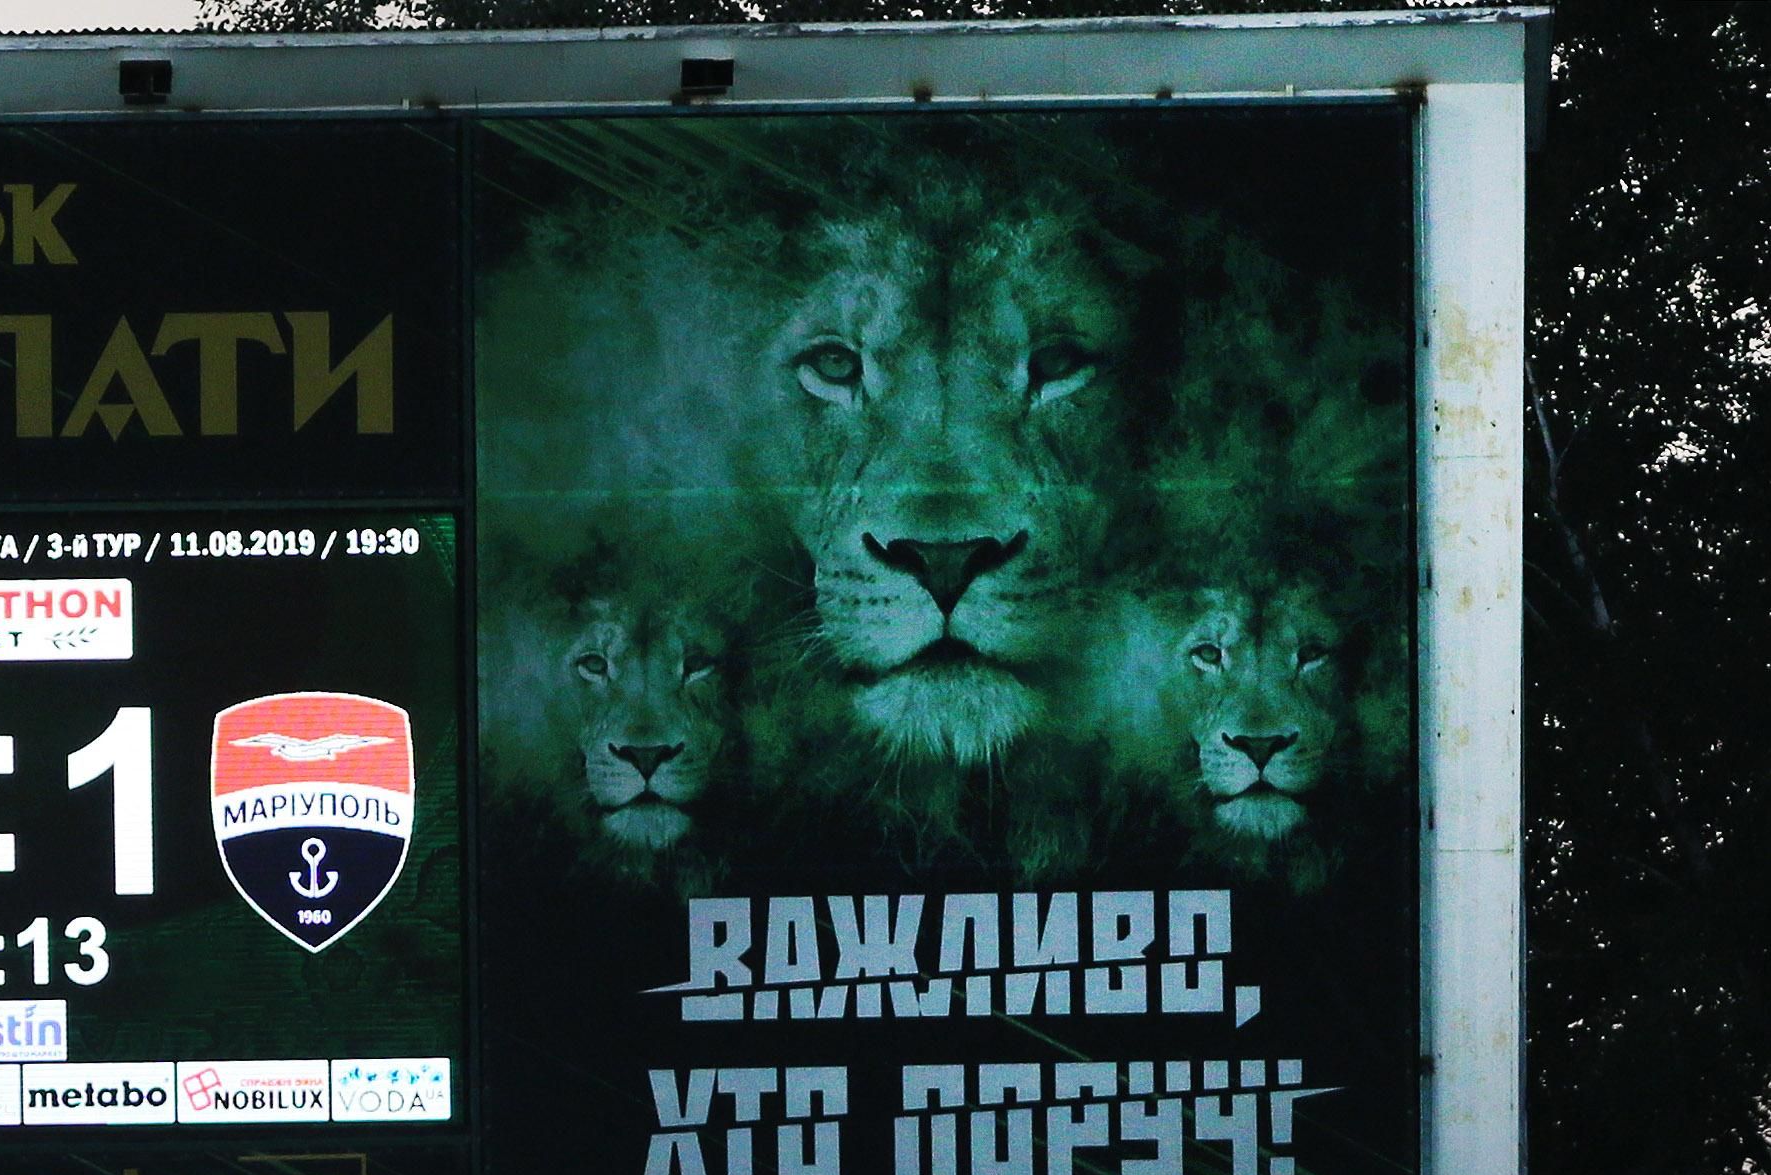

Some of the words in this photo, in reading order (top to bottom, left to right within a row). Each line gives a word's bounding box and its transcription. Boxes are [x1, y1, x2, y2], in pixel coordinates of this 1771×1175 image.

[93, 532, 142, 559] ТУР
[170, 530, 315, 558] 11.08.2019
[346, 528, 420, 556] 19:30
[224, 793, 401, 827] МАРІУПОЛЬ
[297, 909, 332, 924] 1960
[681, 889, 1261, 1029] ВАЖЛИВО,
[28, 1081, 168, 1108] metabo
[215, 1089, 324, 1110] NOBILUX
[338, 1090, 426, 1112] VODA
